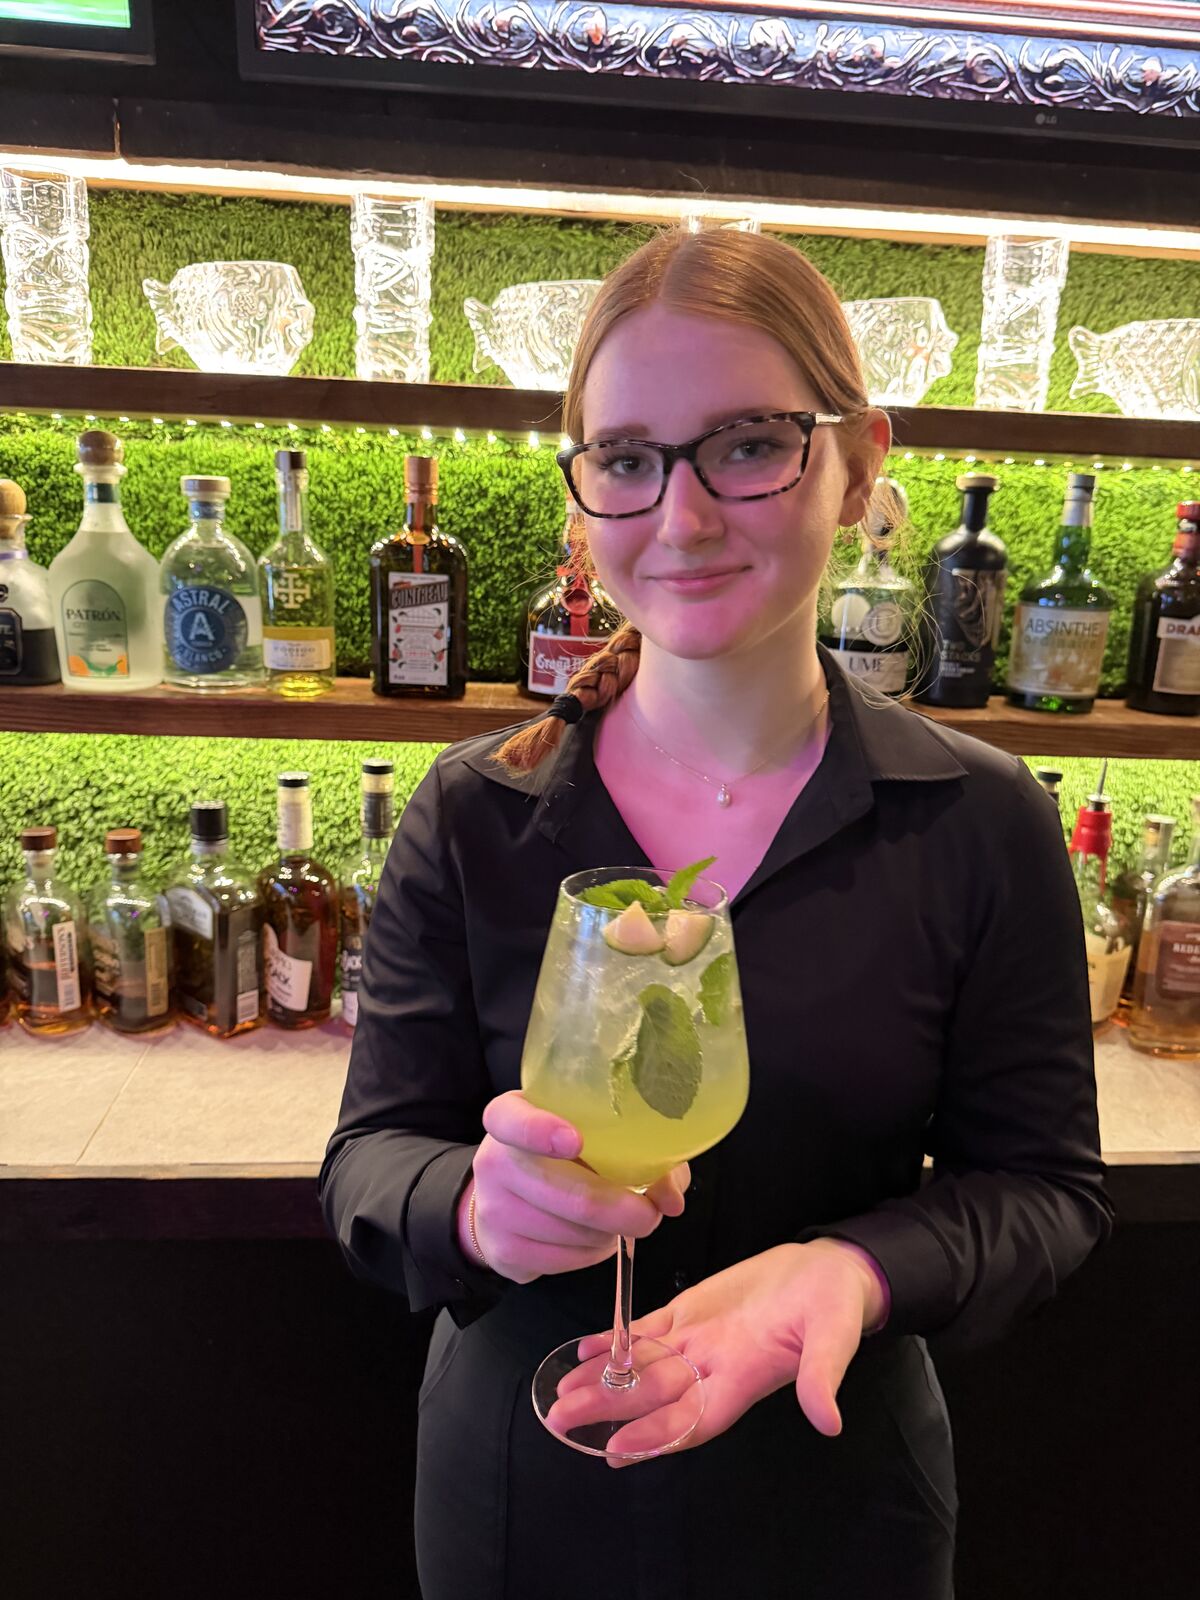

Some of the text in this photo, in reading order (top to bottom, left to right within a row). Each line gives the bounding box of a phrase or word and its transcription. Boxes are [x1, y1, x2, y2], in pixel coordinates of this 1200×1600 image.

[172, 590, 230, 613] ASTRAL
[391, 583, 448, 608] COINTREAU
[66, 607, 122, 621] PATRÓN
[189, 612, 215, 641] A
[1025, 617, 1100, 637] ABSINTHE
[1166, 623, 1200, 636] DRA
